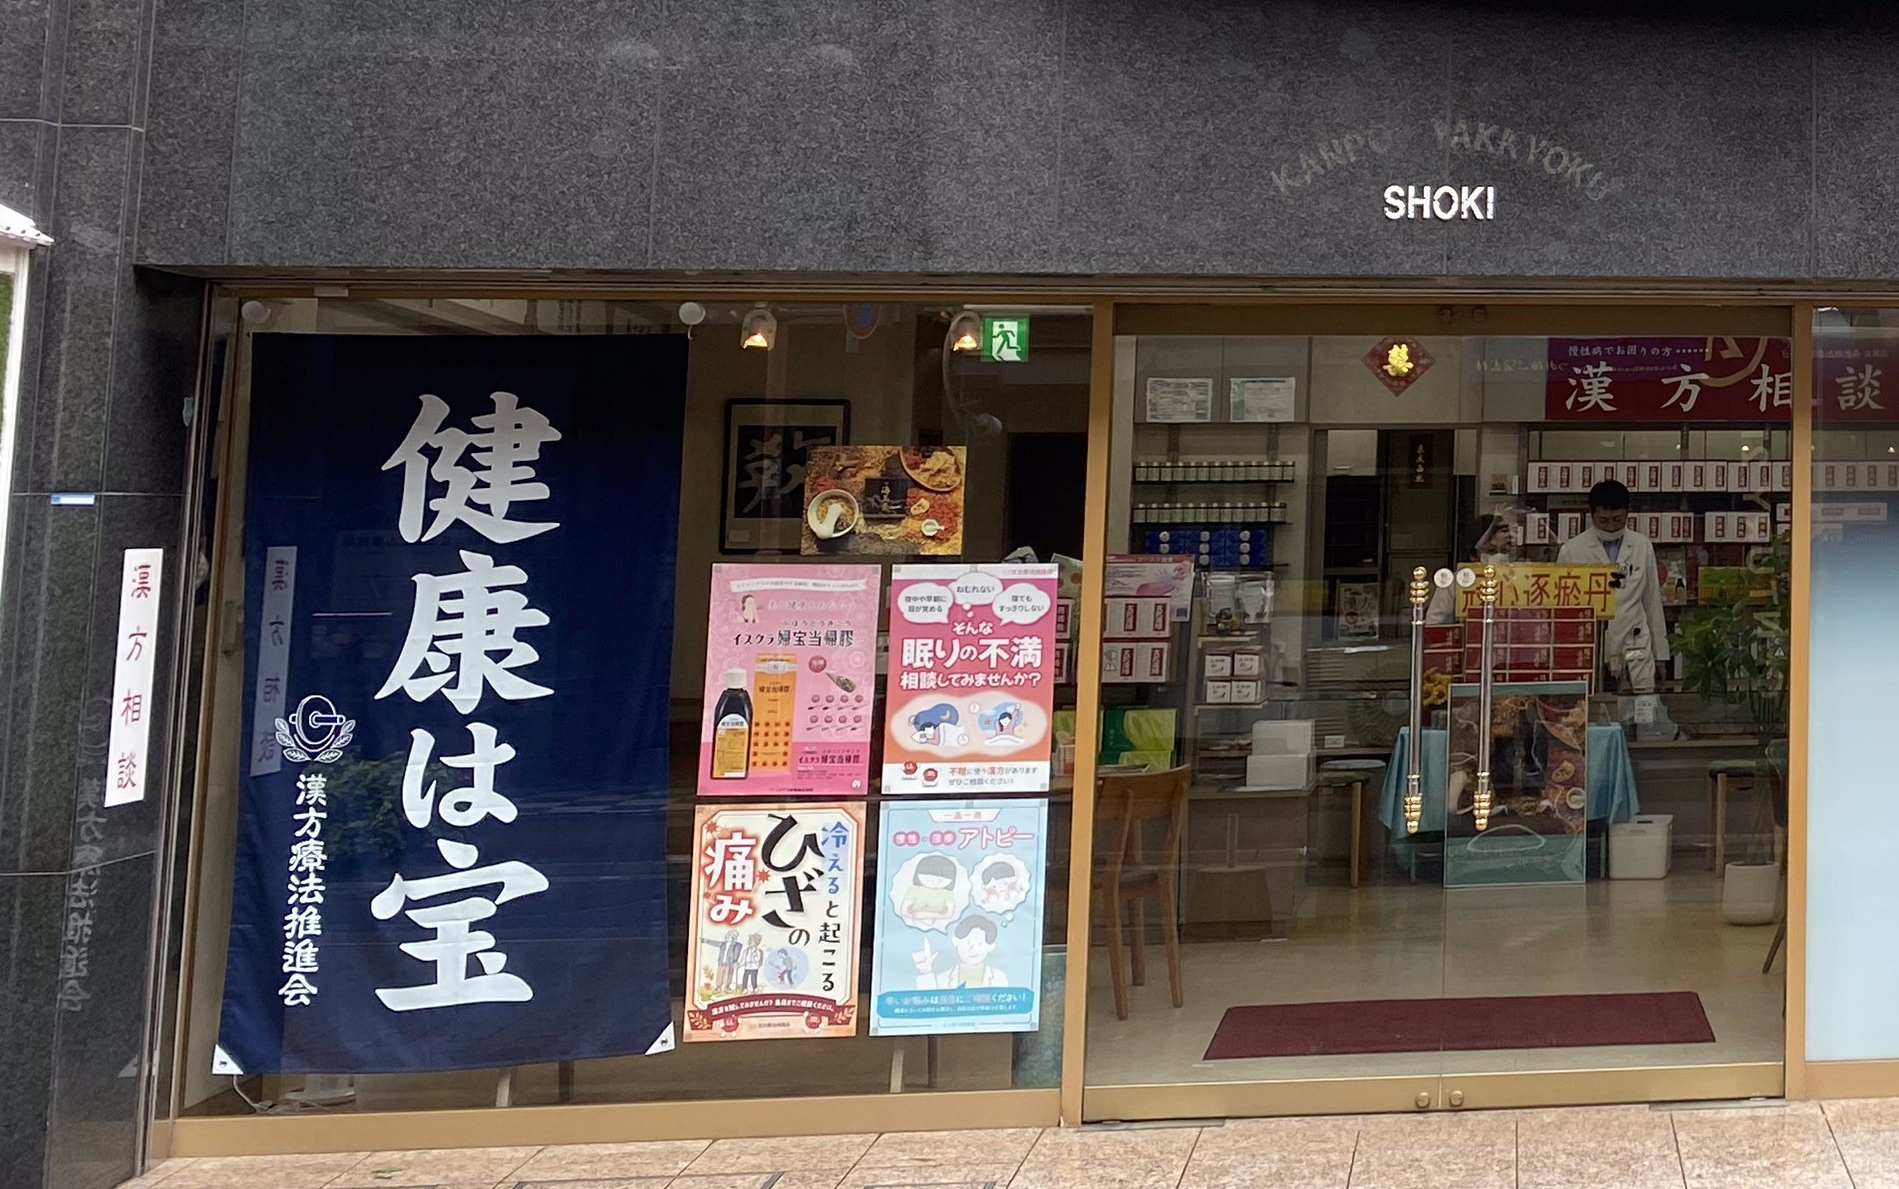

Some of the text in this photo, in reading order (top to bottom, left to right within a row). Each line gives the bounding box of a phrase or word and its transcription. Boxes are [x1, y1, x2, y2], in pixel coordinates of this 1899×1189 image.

[1384, 185, 1494, 220] SHOKI
[953, 620, 994, 636] そんな
[956, 585, 995, 594] ねむれない
[901, 636, 1044, 669] 眠りの不満
[370, 391, 562, 1012] 健康は宝
[279, 773, 329, 1006] 漢方療法推進会
[704, 832, 757, 926] 痛み
[761, 813, 826, 947] ひざの
[818, 821, 850, 992] 冷えると起こる
